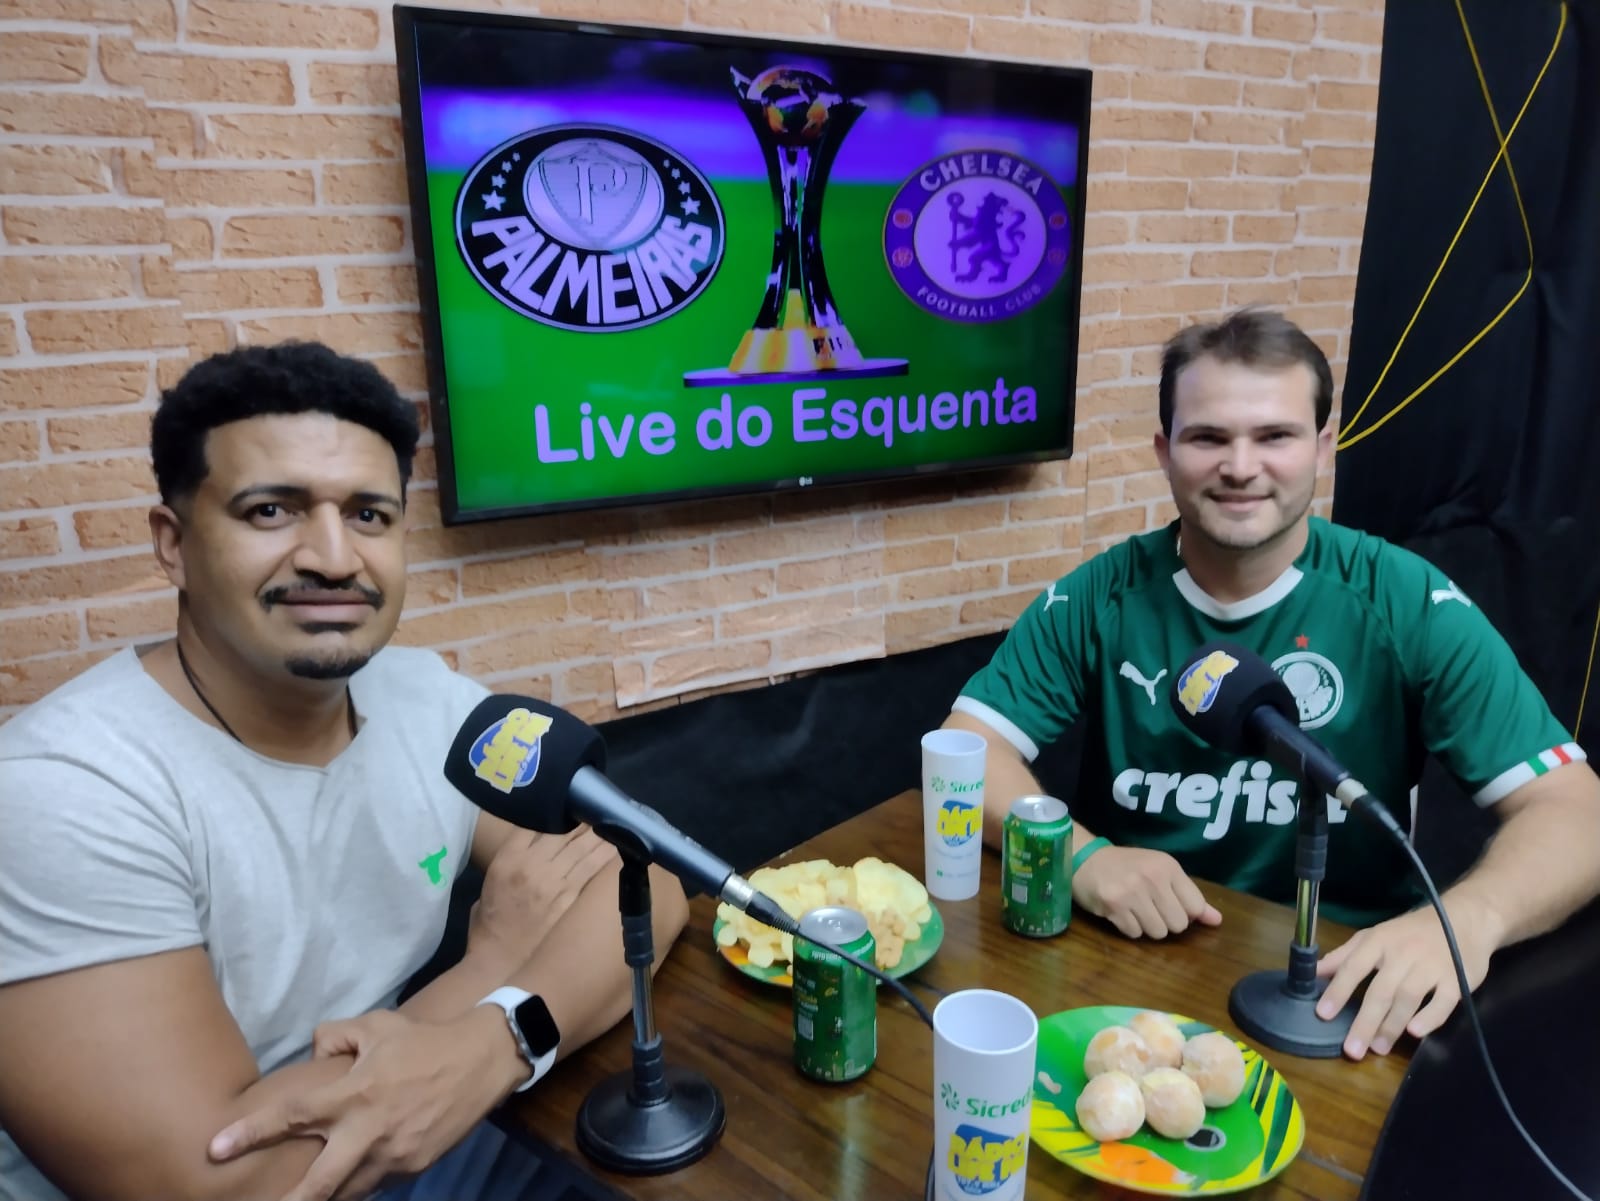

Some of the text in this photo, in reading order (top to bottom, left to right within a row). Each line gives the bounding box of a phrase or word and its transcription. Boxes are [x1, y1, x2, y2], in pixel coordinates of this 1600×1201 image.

[919, 154, 1043, 196] CHELSEA
[471, 214, 713, 325] PALMEIRAS
[916, 282, 1042, 319] FOOTBALL CLUB
[534, 376, 1037, 463] Live do Esquenta
